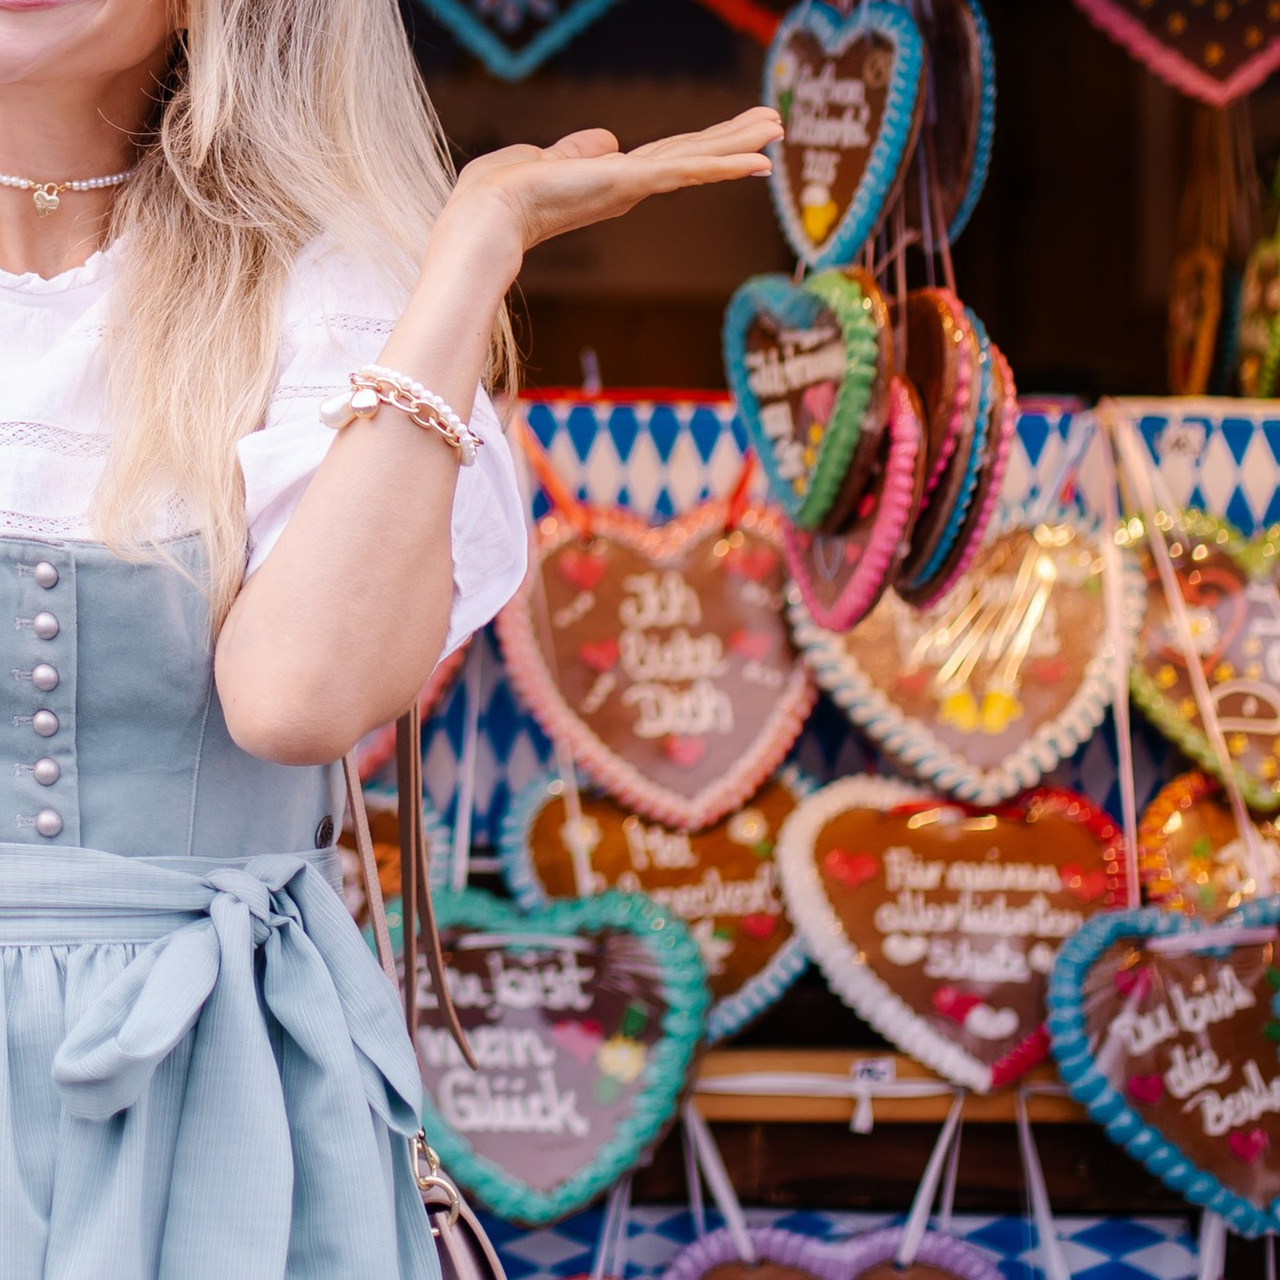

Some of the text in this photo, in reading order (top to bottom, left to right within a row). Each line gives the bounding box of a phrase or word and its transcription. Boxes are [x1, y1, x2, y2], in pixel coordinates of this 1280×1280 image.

[621, 679, 736, 738] Dich
[1163, 1042, 1232, 1101] die
[438, 1069, 589, 1137] Glück
